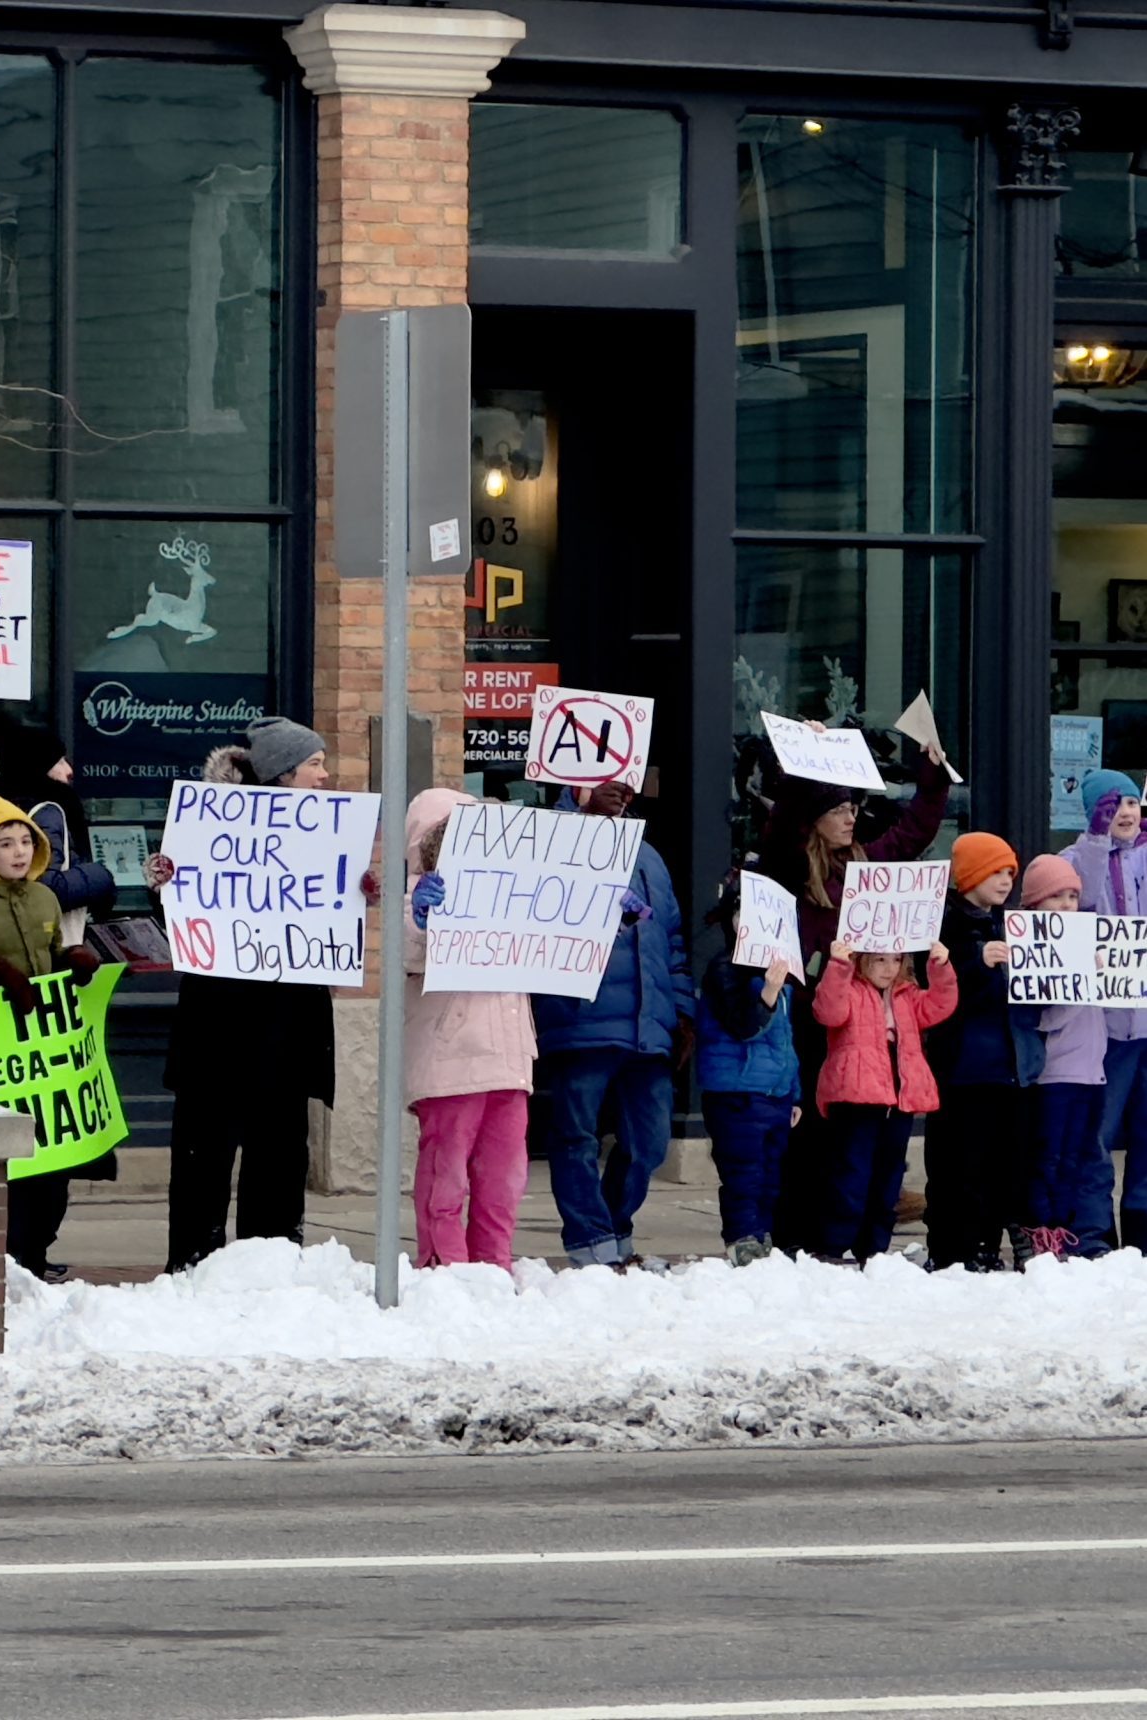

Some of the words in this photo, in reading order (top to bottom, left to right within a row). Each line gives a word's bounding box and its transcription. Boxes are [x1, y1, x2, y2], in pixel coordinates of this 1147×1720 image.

[474, 517, 518, 545] 03
[483, 671, 532, 688] RENT
[96, 696, 193, 727] Whitepine
[195, 698, 264, 722] Studios
[468, 729, 530, 745] 730-56
[548, 710, 612, 763] AI
[83, 765, 118, 777] SHOP
[128, 765, 179, 777] CREATE
[175, 785, 351, 834] PROTECT
[210, 834, 289, 871] OUR
[452, 803, 640, 873] TAXATION
[172, 855, 347, 913] FUTURE!
[859, 866, 890, 893] NO
[897, 866, 946, 893] DATA
[433, 869, 630, 931] WITHOUT
[847, 899, 942, 940] CENTER
[1032, 912, 1064, 940] NO
[172, 917, 216, 971] NO
[232, 919, 282, 982] Big
[286, 917, 363, 971] Data!
[429, 929, 610, 974] REPRESENTATION
[1011, 943, 1064, 969] DATA
[1010, 973, 1091, 1002] CENTER!
[2, 976, 84, 1042] THE
